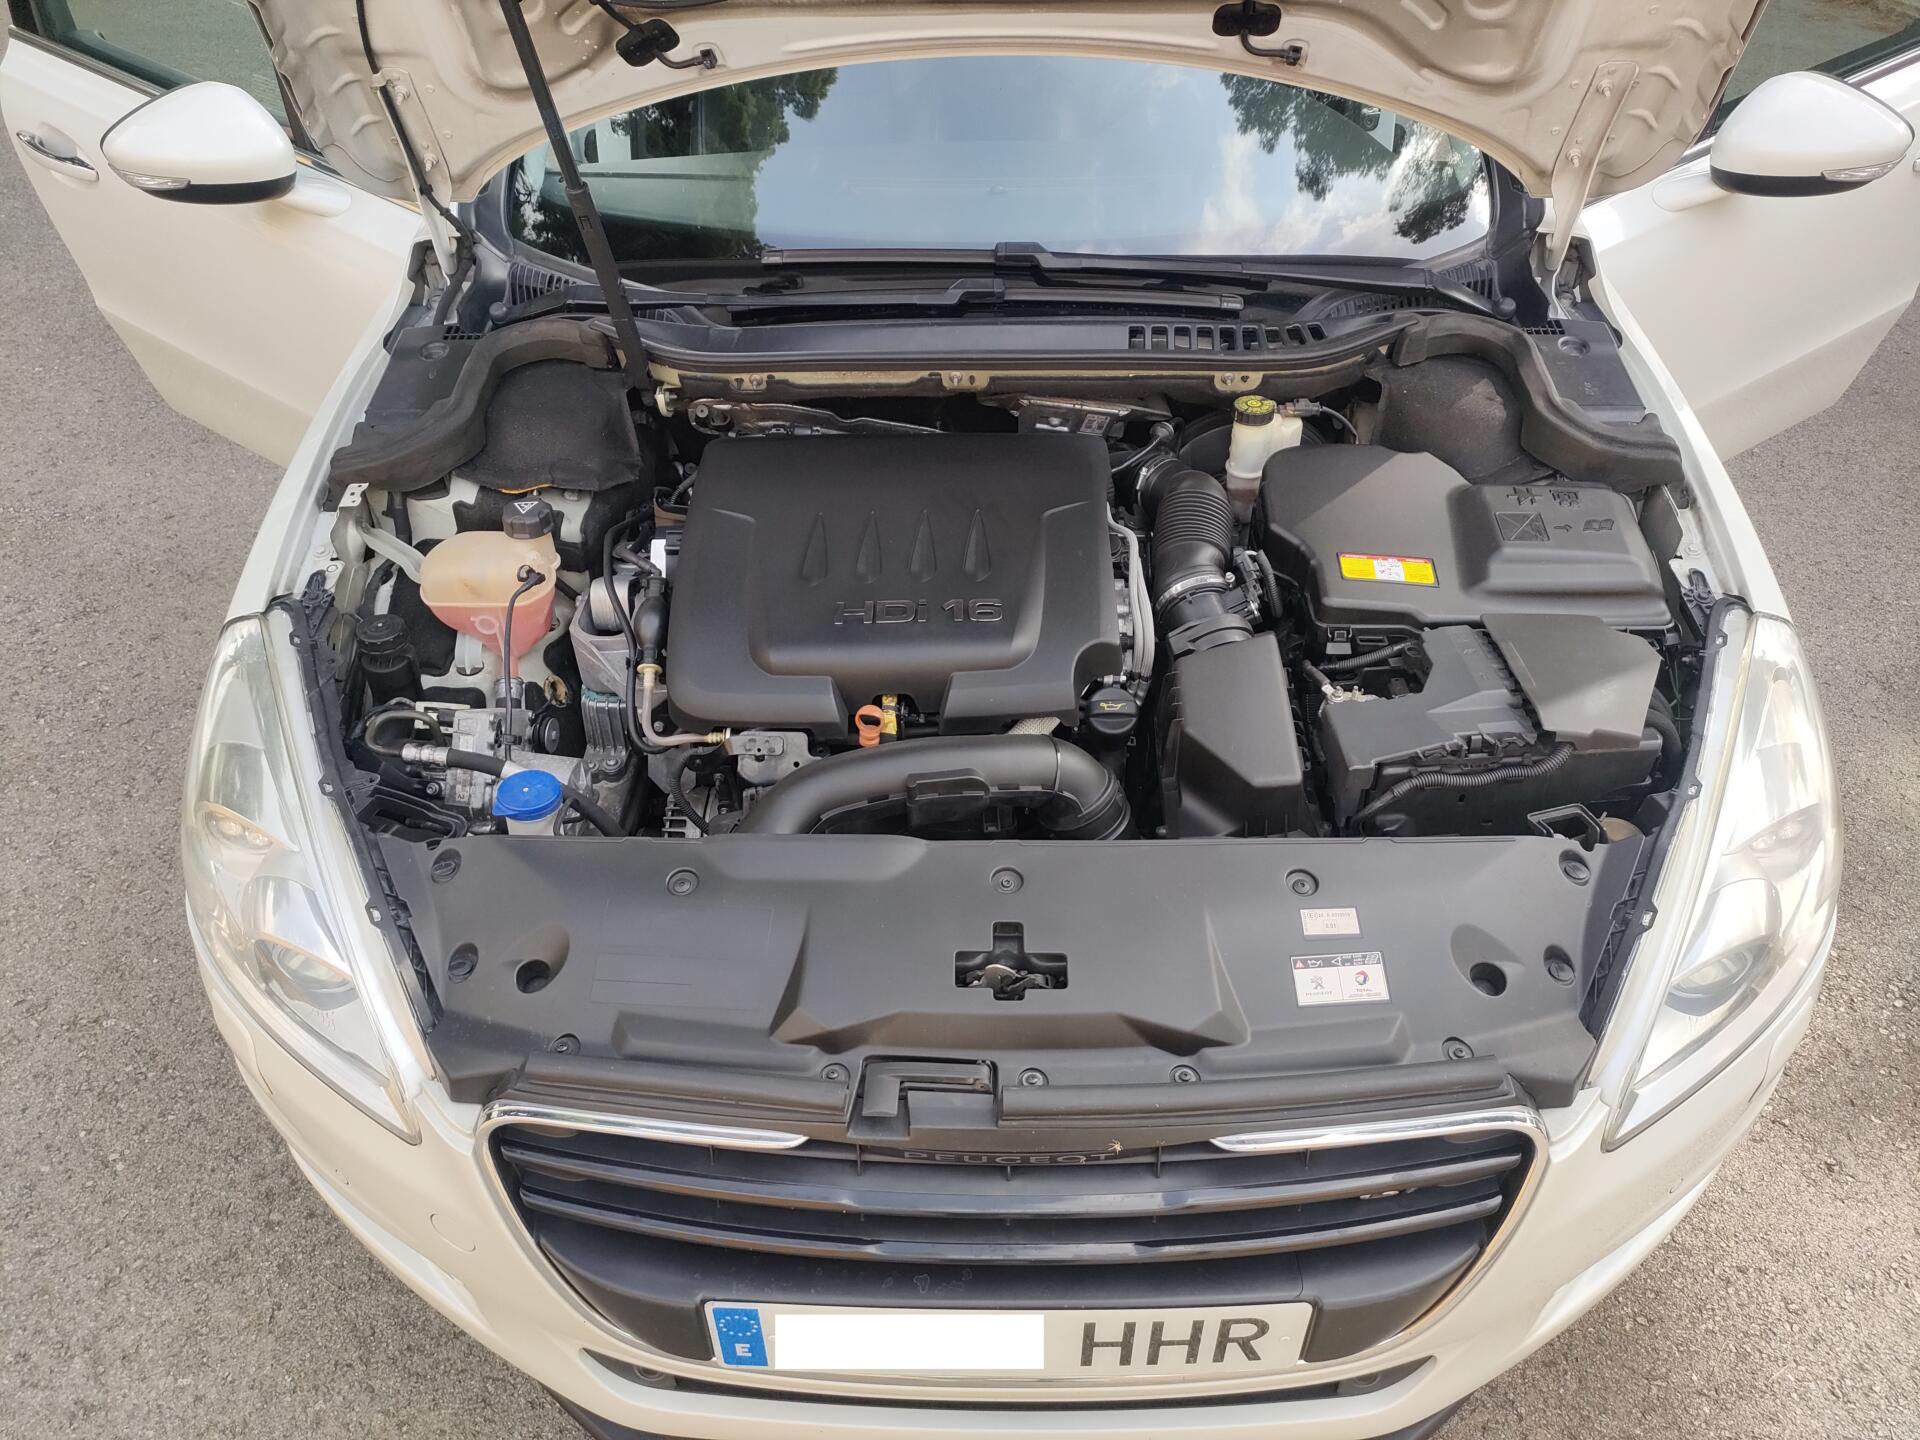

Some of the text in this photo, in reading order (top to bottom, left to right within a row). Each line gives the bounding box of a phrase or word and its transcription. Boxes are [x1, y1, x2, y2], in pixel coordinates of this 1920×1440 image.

[834, 598, 1004, 625] HDi 16
[903, 1151, 1116, 1164] PEUGEOT
[735, 1343, 752, 1357] E
[1080, 1317, 1271, 1368] HHR
